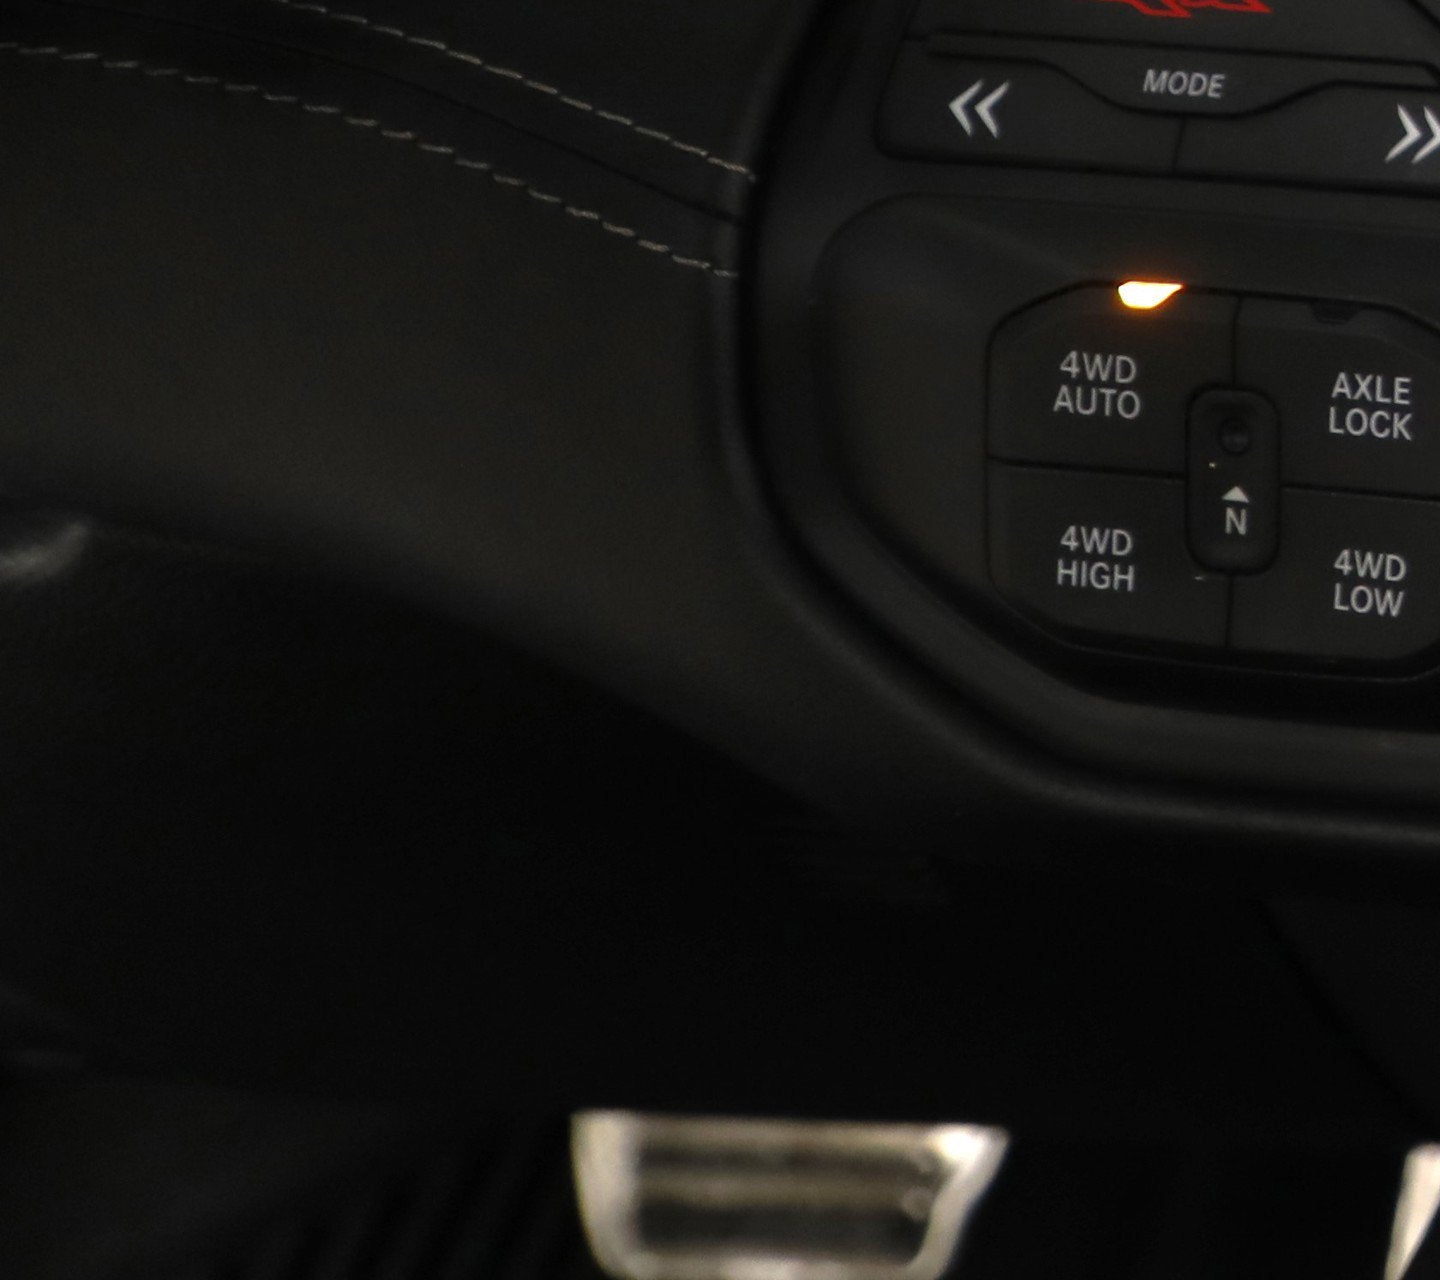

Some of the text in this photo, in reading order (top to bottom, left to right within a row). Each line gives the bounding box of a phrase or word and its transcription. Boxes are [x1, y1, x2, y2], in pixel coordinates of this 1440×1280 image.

[1142, 69, 1225, 99] MODE
[1059, 350, 1137, 384] 4WD
[1053, 384, 1140, 419] AUTO
[1331, 372, 1412, 405] AXLE
[1328, 406, 1412, 441] LOCK
[1225, 507, 1247, 535] N
[1060, 525, 1133, 557] 4WD
[1056, 559, 1135, 592] HIGH
[1334, 549, 1406, 583] 4WD
[1333, 583, 1405, 617] LOW
